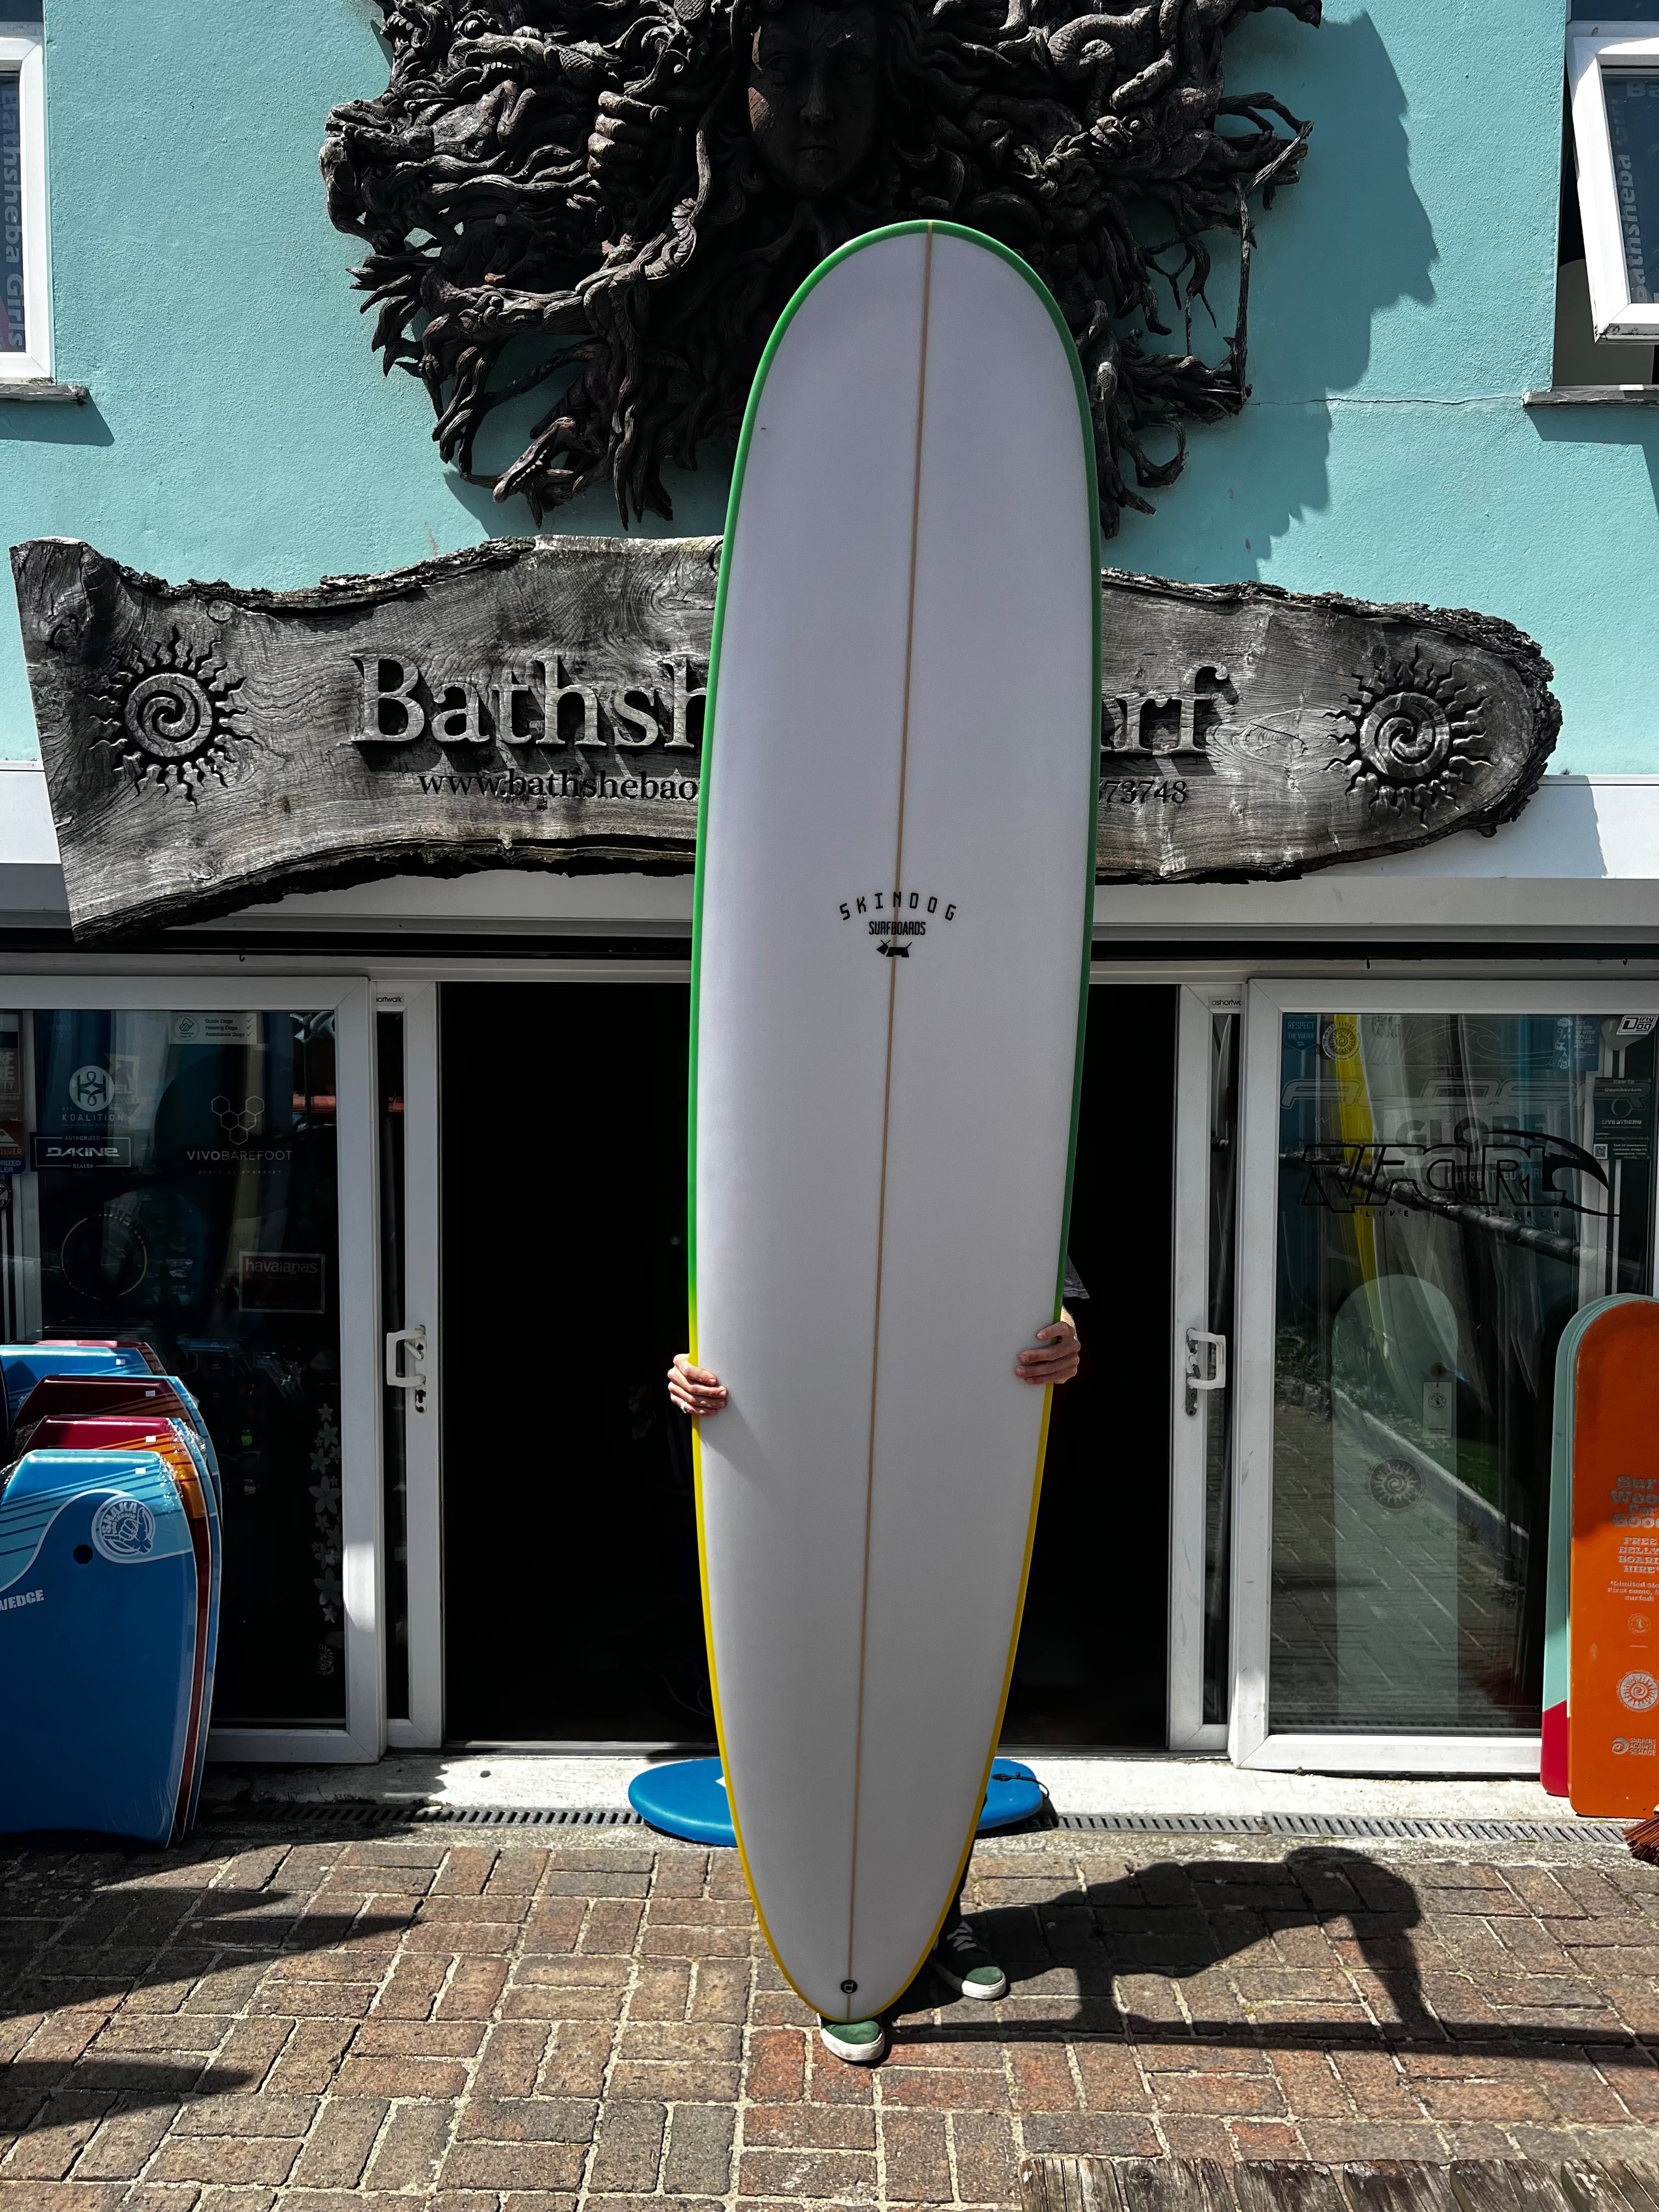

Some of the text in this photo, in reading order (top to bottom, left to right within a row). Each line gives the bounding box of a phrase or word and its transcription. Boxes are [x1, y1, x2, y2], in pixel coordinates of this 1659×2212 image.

[2, 90, 25, 346] Bathsheba Girls
[1101, 661, 1229, 753] rf
[419, 769, 1187, 804] www.bathshebao 73748
[839, 891, 957, 921] SKINDOG
[868, 921, 926, 935] SURFBOARDS
[1288, 1022, 1314, 1030] RESPECT
[45, 1147, 121, 1157] DAKINE
[186, 1150, 293, 1161] VIVOBAREFOOT
[1365, 1209, 1409, 1217] LIVE
[1485, 1210, 1559, 1218] SEARCH
[245, 1258, 318, 1274] havaianas
[1623, 1537, 1657, 1545] FREE
